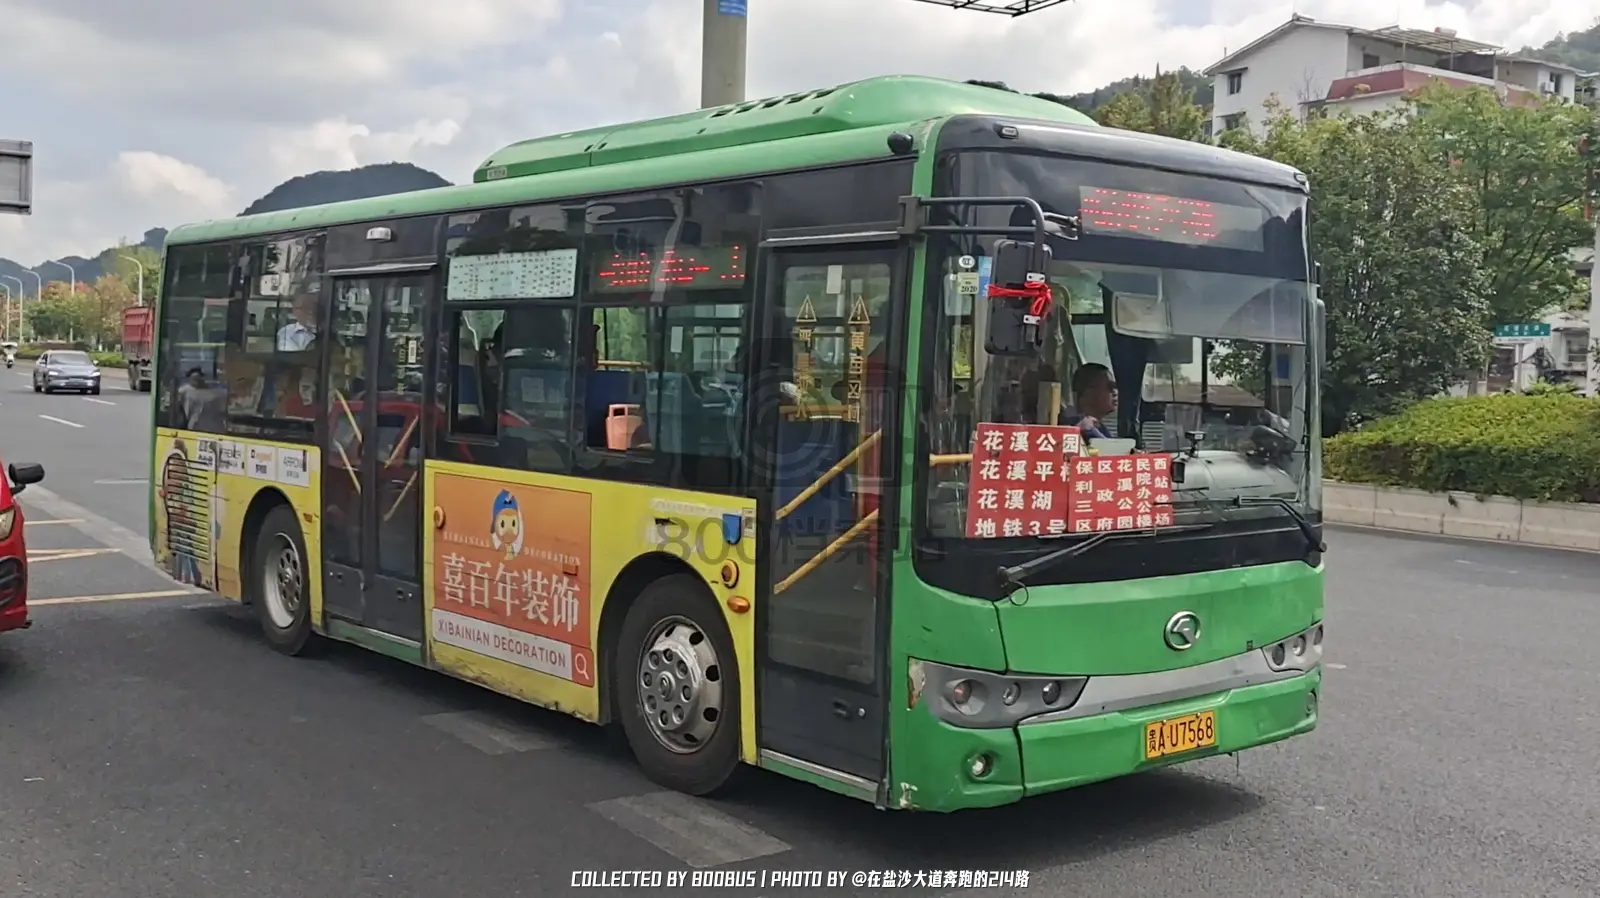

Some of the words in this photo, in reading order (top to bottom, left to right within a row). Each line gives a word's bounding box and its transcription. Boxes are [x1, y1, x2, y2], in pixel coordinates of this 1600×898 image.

[982, 431, 1080, 454] 花溪公园
[977, 489, 1053, 510] 花溪湖
[1074, 461, 1094, 532] 保利三区
[1096, 460, 1114, 531] 区政府
[1116, 459, 1133, 529] 花溪公园
[1136, 458, 1152, 528] 民院办公楼
[1153, 457, 1170, 526] 西站货场
[524, 548, 581, 565] DECORATION
[975, 519, 1067, 539] 地铁3号
[441, 552, 581, 632] 喜百年装饰
[438, 619, 490, 645] XIBAINIAN
[493, 637, 566, 668] DECORATION
